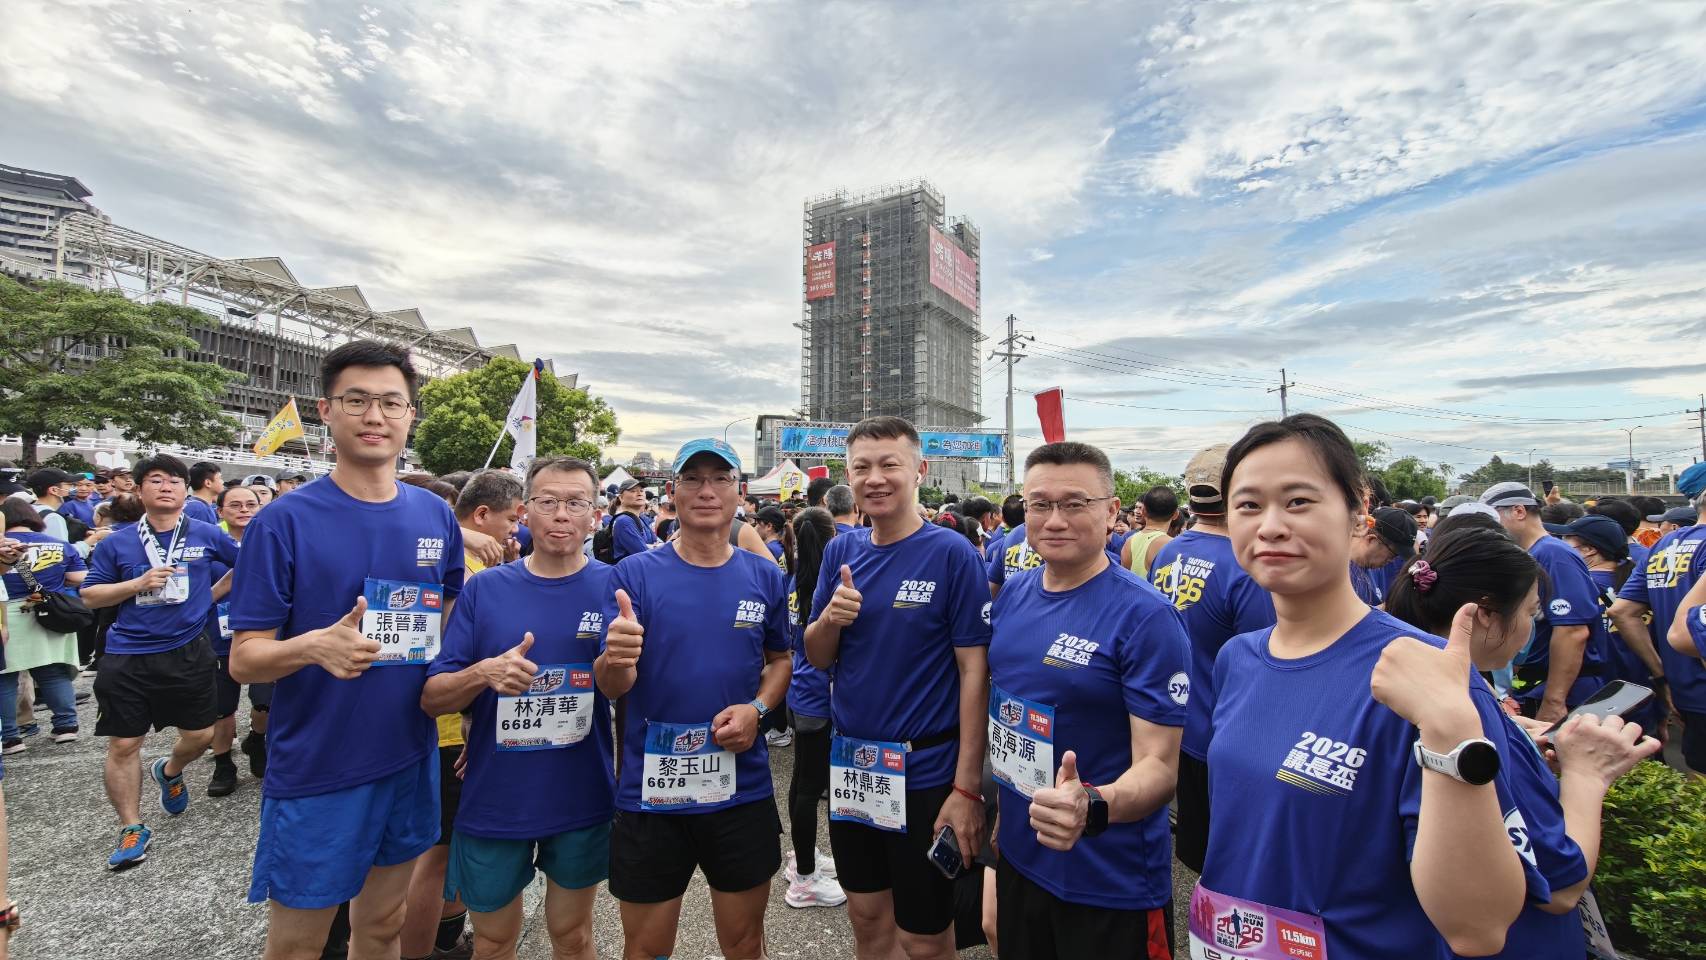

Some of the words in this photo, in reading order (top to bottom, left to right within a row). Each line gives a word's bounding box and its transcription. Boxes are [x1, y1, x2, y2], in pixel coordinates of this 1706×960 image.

[417, 538, 443, 548] 2026
[1183, 564, 1212, 579] RUN
[900, 580, 936, 592] 2026
[1154, 565, 1205, 603] 2026
[392, 592, 416, 603] 2026
[738, 600, 766, 614] 2026
[1552, 604, 1569, 612] SYM
[376, 612, 428, 632] 張晉嘉
[582, 612, 602, 622] 20
[577, 621, 602, 632] 議長
[366, 633, 400, 645] 6680
[1054, 633, 1100, 653] 2026
[1047, 644, 1093, 666] 議長盃
[514, 695, 579, 718] 林清華
[501, 717, 543, 731] 6684
[675, 736, 705, 747] 2026
[992, 721, 1036, 762] 高海源
[1294, 731, 1368, 768] 2026
[658, 755, 720, 776] 黎玉山
[1281, 747, 1360, 791] 議長盃
[647, 777, 686, 788] 6678
[843, 768, 891, 796] 林鼎泰
[834, 788, 865, 803] 6675
[1507, 827, 1532, 853] SY
[1217, 916, 1264, 944] 2026
[1243, 917, 1264, 928] RUN
[1281, 928, 1316, 947] 11.5km
